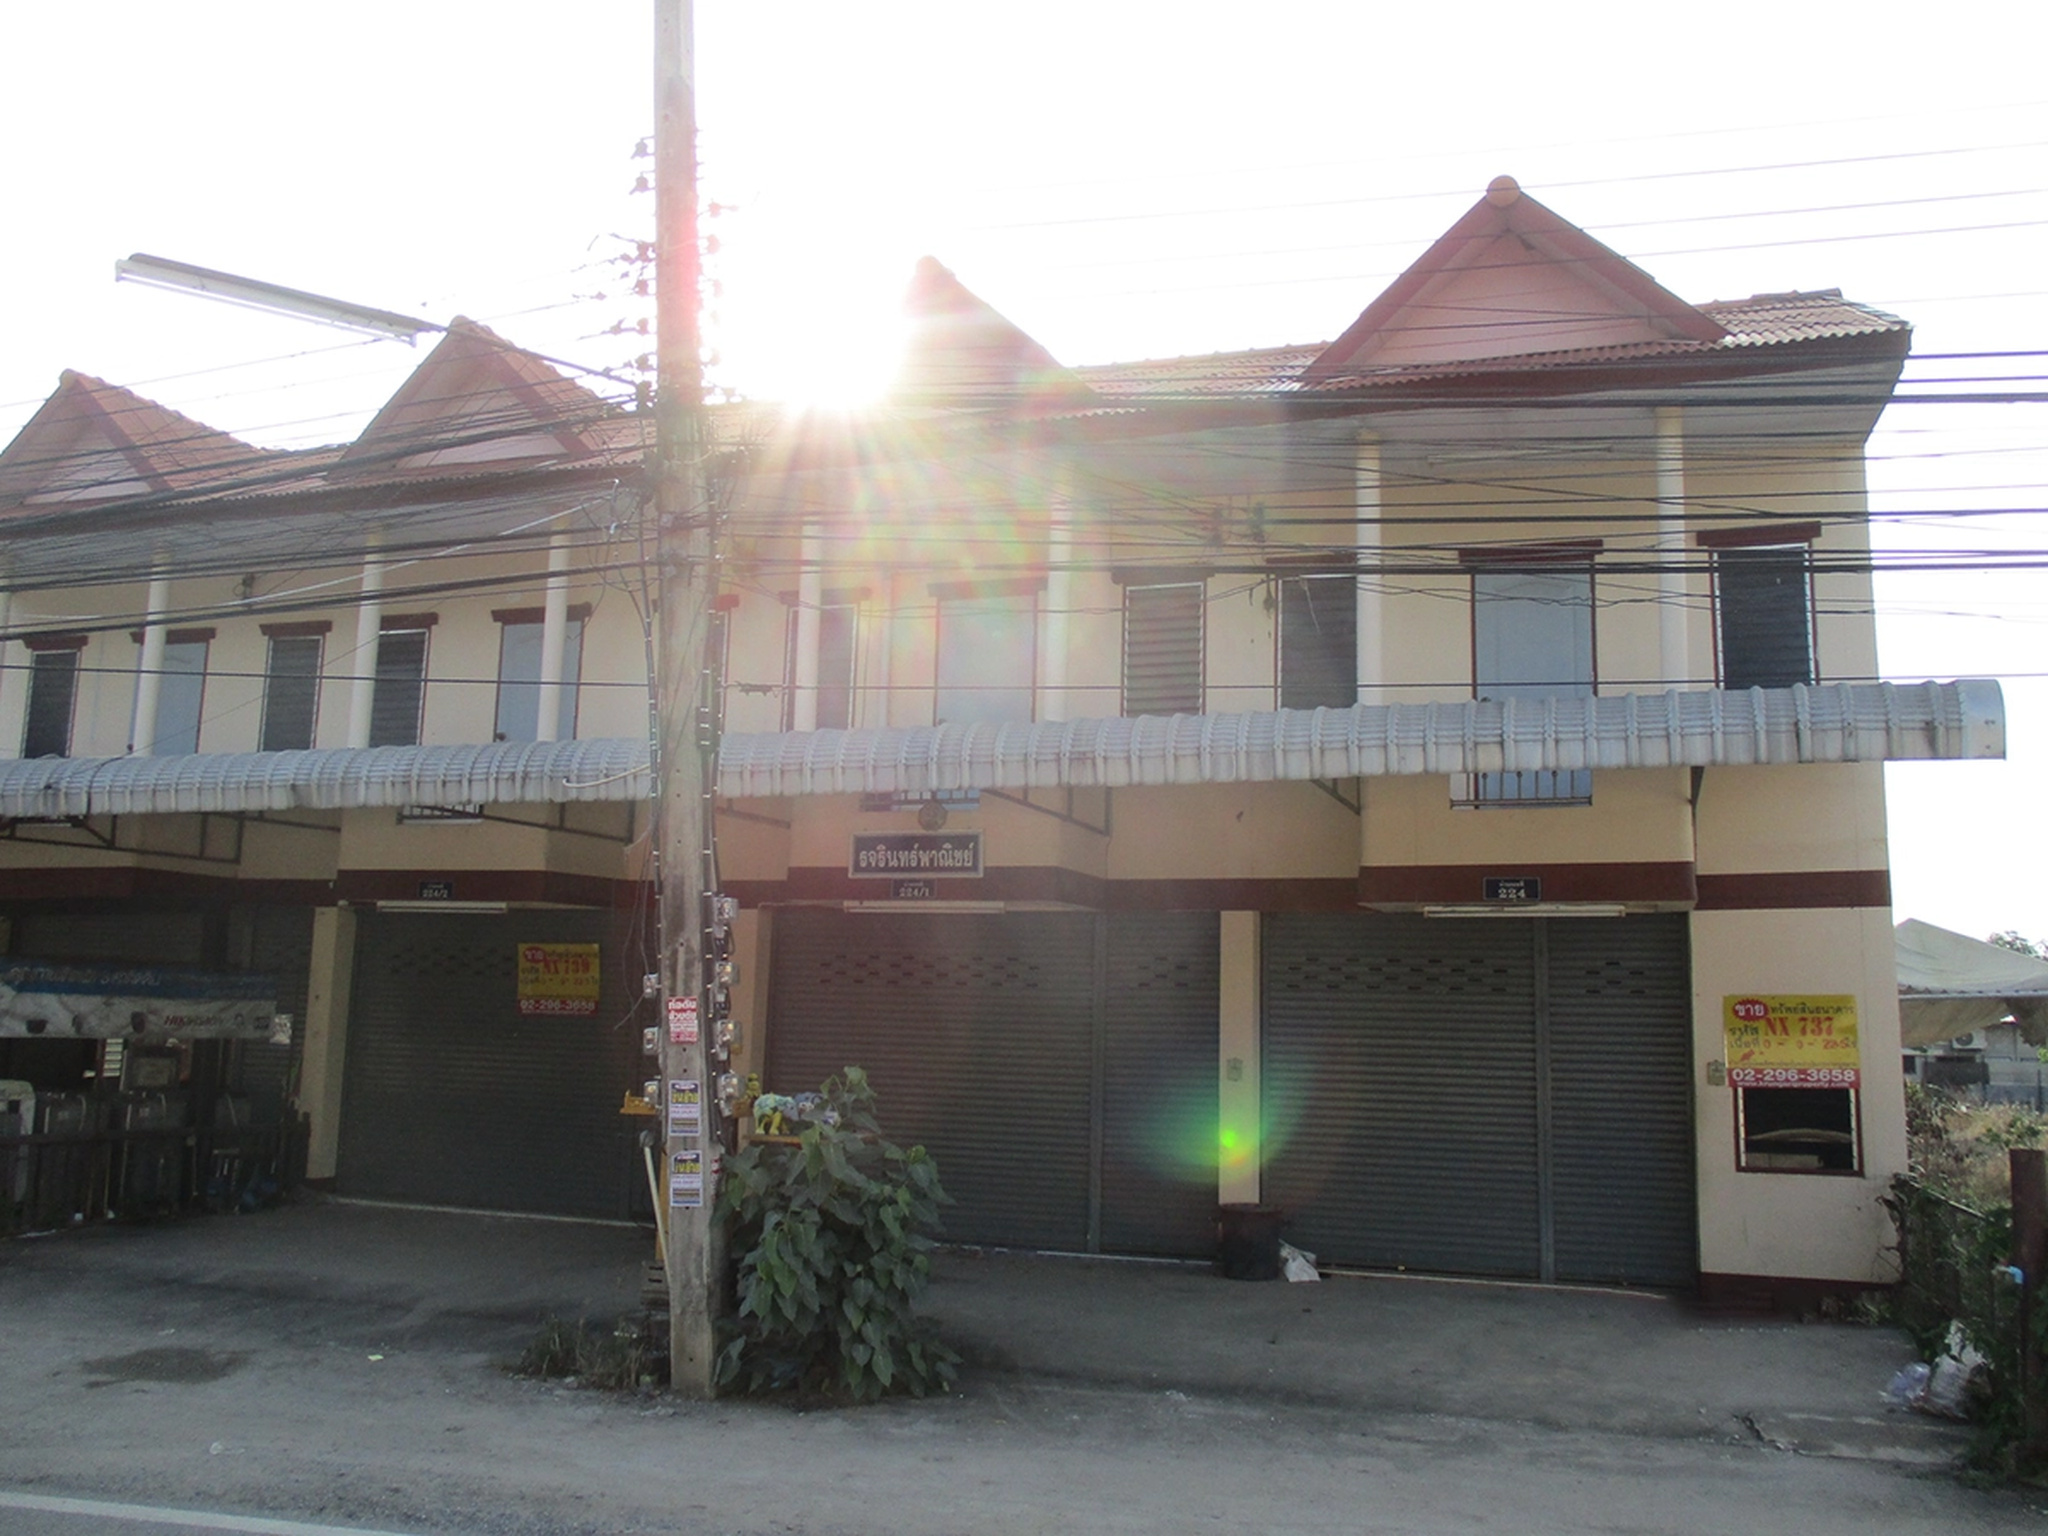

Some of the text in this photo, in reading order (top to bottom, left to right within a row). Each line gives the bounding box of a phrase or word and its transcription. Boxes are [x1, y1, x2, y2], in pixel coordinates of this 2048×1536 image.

[898, 887, 930, 897] 224/1
[1497, 887, 1526, 898] 224
[1734, 1004, 1765, 1016] ขาย
[1764, 1016, 1790, 1036] NX
[1798, 1016, 1834, 1036] 737
[1731, 1068, 1856, 1082] 02-296-3658
